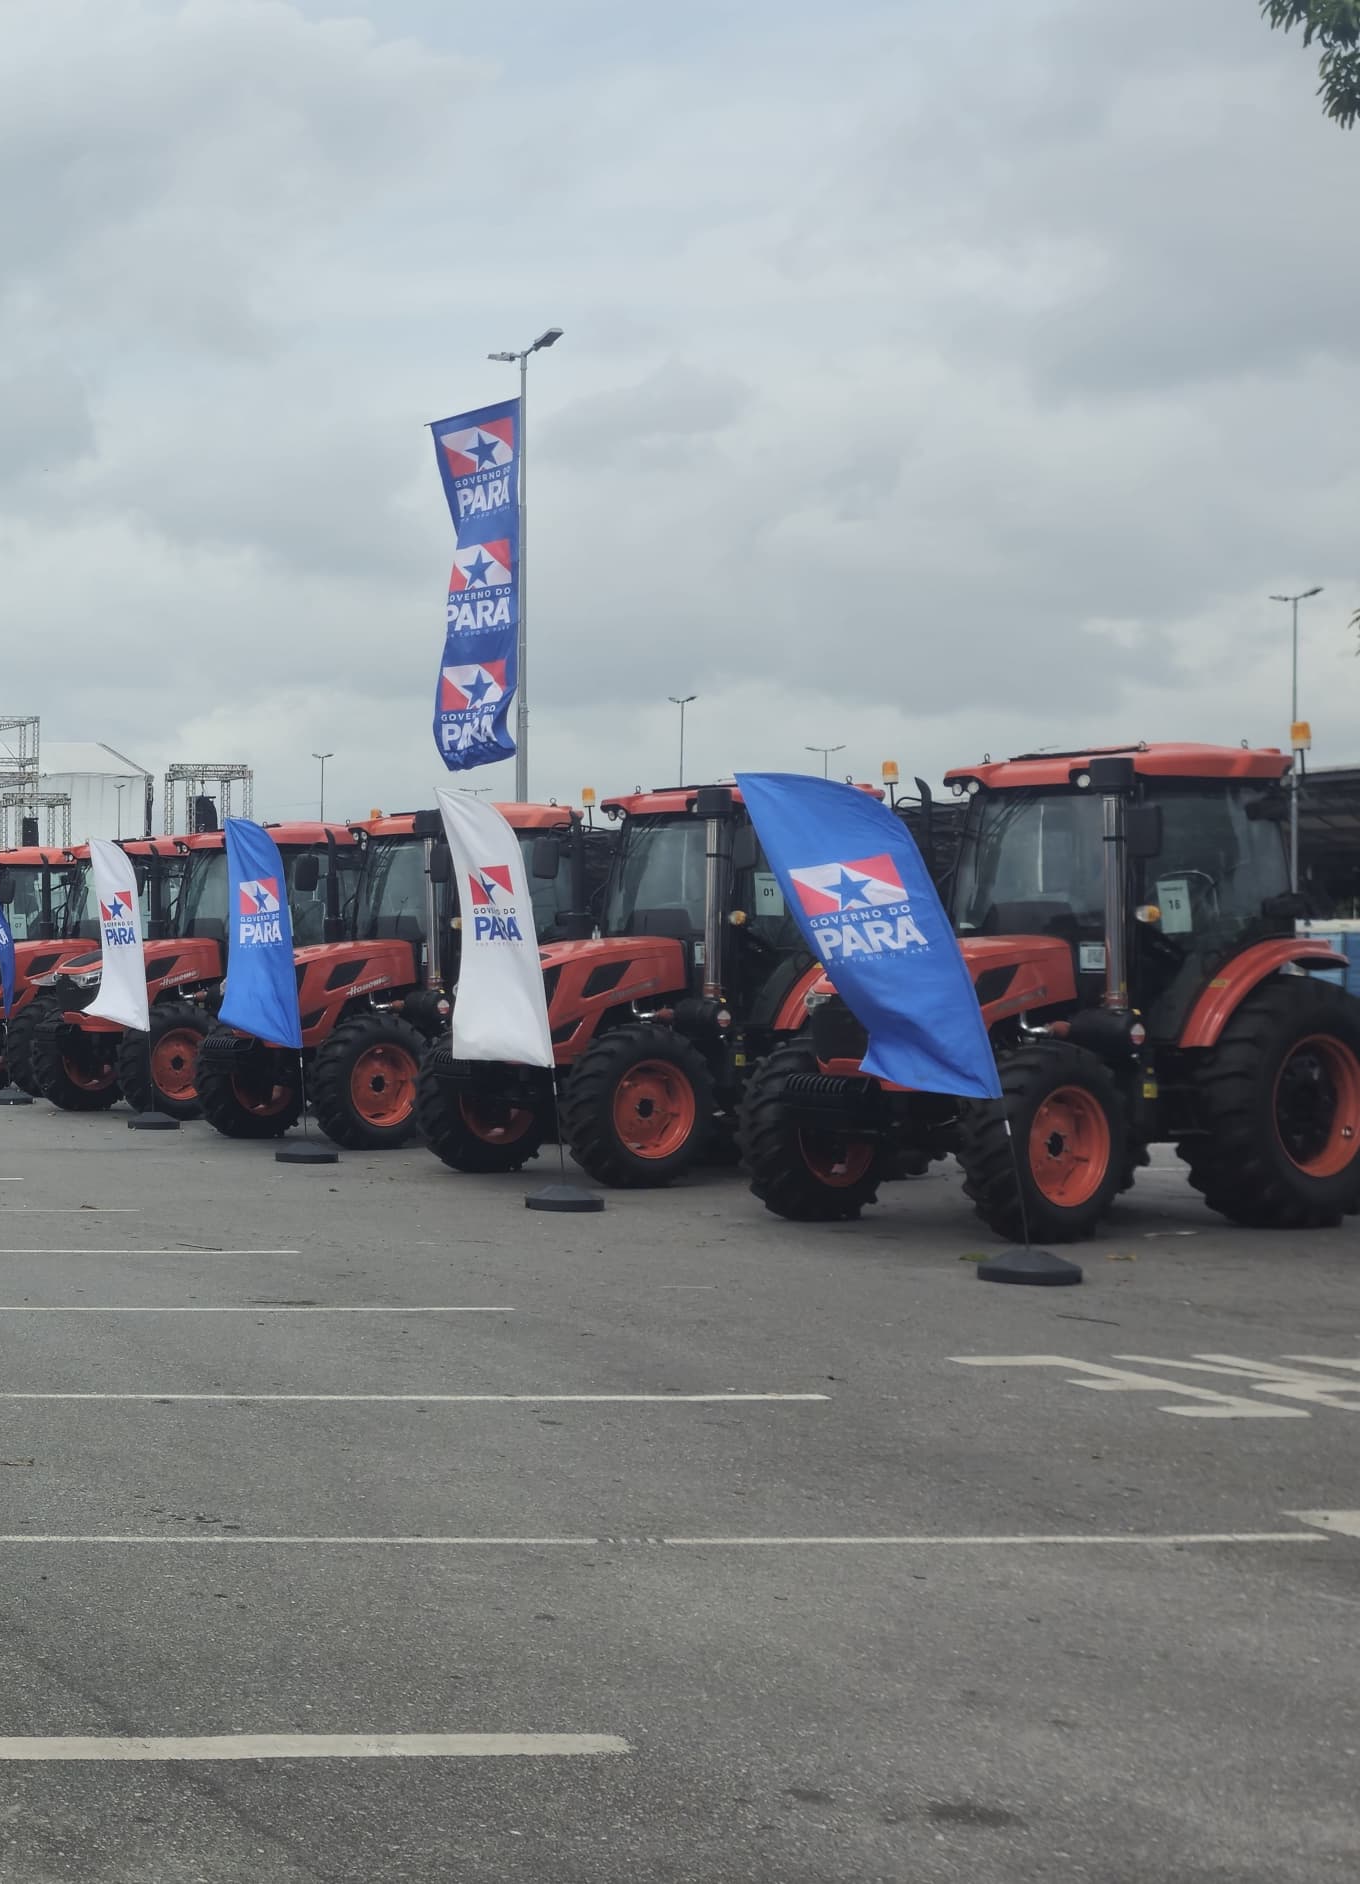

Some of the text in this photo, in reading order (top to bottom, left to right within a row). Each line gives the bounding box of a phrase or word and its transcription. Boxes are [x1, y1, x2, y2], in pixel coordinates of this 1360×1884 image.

[448, 587, 511, 602] OVERNO DO
[763, 887, 774, 897] 01
[810, 904, 911, 928] GOVERNO DO
